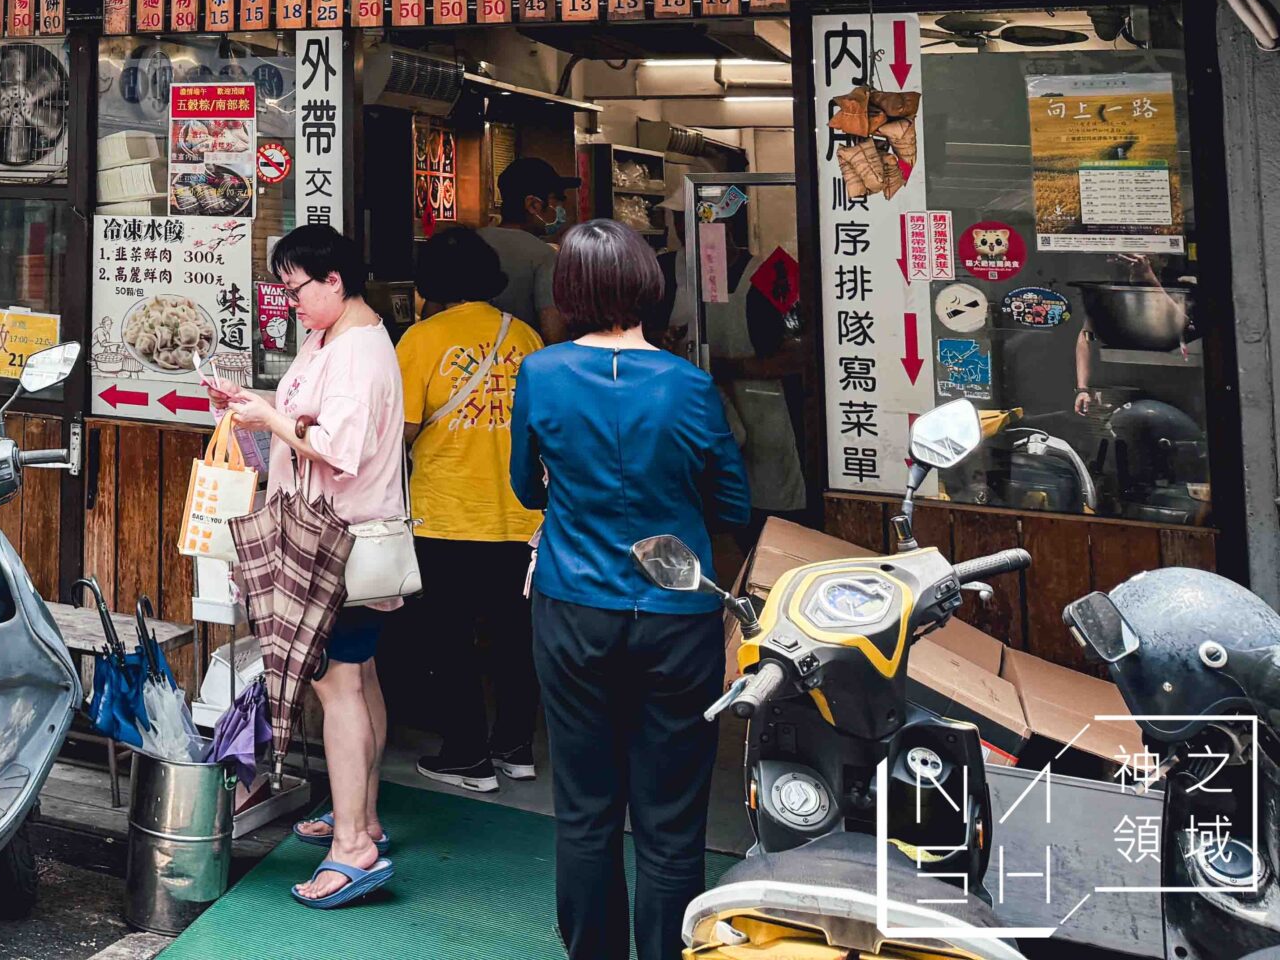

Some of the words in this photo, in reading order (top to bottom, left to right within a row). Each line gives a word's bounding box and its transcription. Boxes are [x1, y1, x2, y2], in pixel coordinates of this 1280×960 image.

[245, 7, 264, 21] 15
[283, 4, 302, 19] 18
[317, 5, 338, 21] 25
[359, 2, 381, 17] 50
[400, 3, 421, 18] 50
[440, 1, 463, 17] 50
[483, 0, 506, 16] 50
[14, 14, 32, 27] 50
[44, 16, 60, 29] 60
[142, 13, 160, 27] 40
[176, 12, 194, 26] 80
[211, 11, 229, 25] 15
[1047, 97, 1158, 118] 向上一路
[103, 218, 185, 242] 冷凍水餃
[114, 247, 172, 262] 韭菜鮮肉
[183, 250, 225, 265] 300元
[114, 268, 172, 283] 高麗鮮肉
[183, 271, 225, 286] 300元
[261, 284, 285, 296] WAN
[264, 295, 286, 307] FUN
[216, 284, 250, 352] 味道
